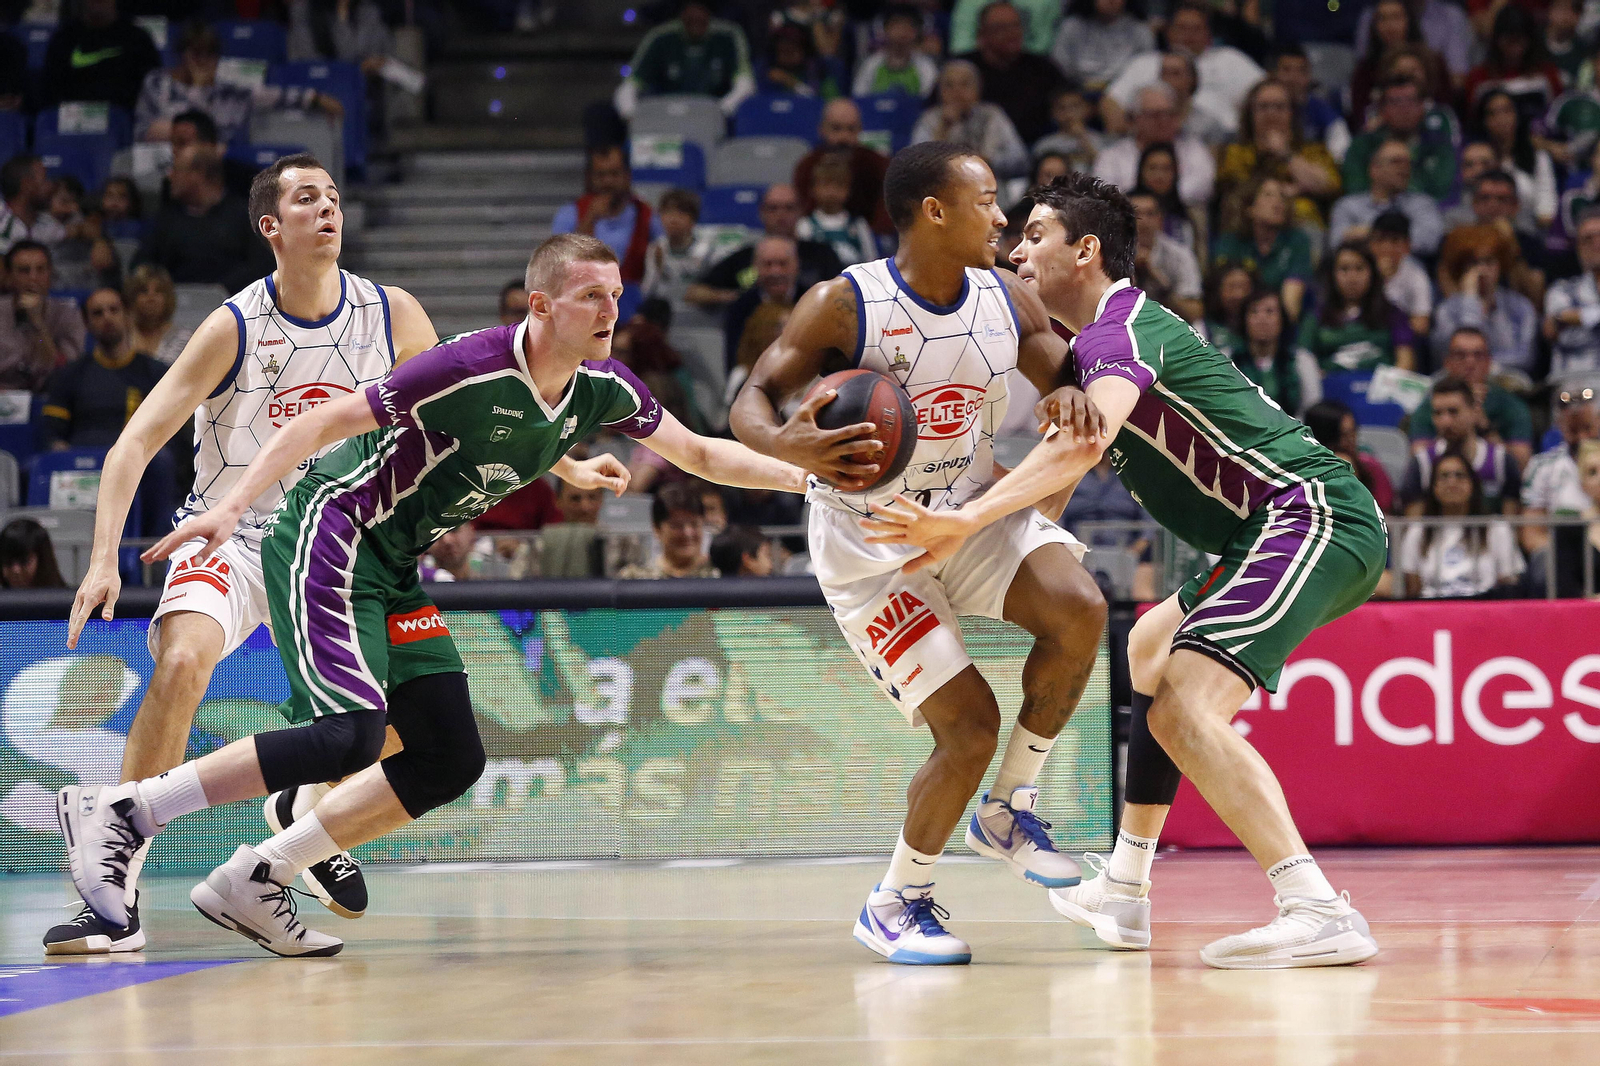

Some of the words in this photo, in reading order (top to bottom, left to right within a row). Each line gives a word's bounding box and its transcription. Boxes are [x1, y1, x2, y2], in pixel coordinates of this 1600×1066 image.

[881, 325, 914, 338] hummel
[257, 336, 287, 347] hummel
[491, 405, 524, 419] SPALDING
[917, 397, 984, 425] ELTECO
[865, 590, 925, 650] AVIA
